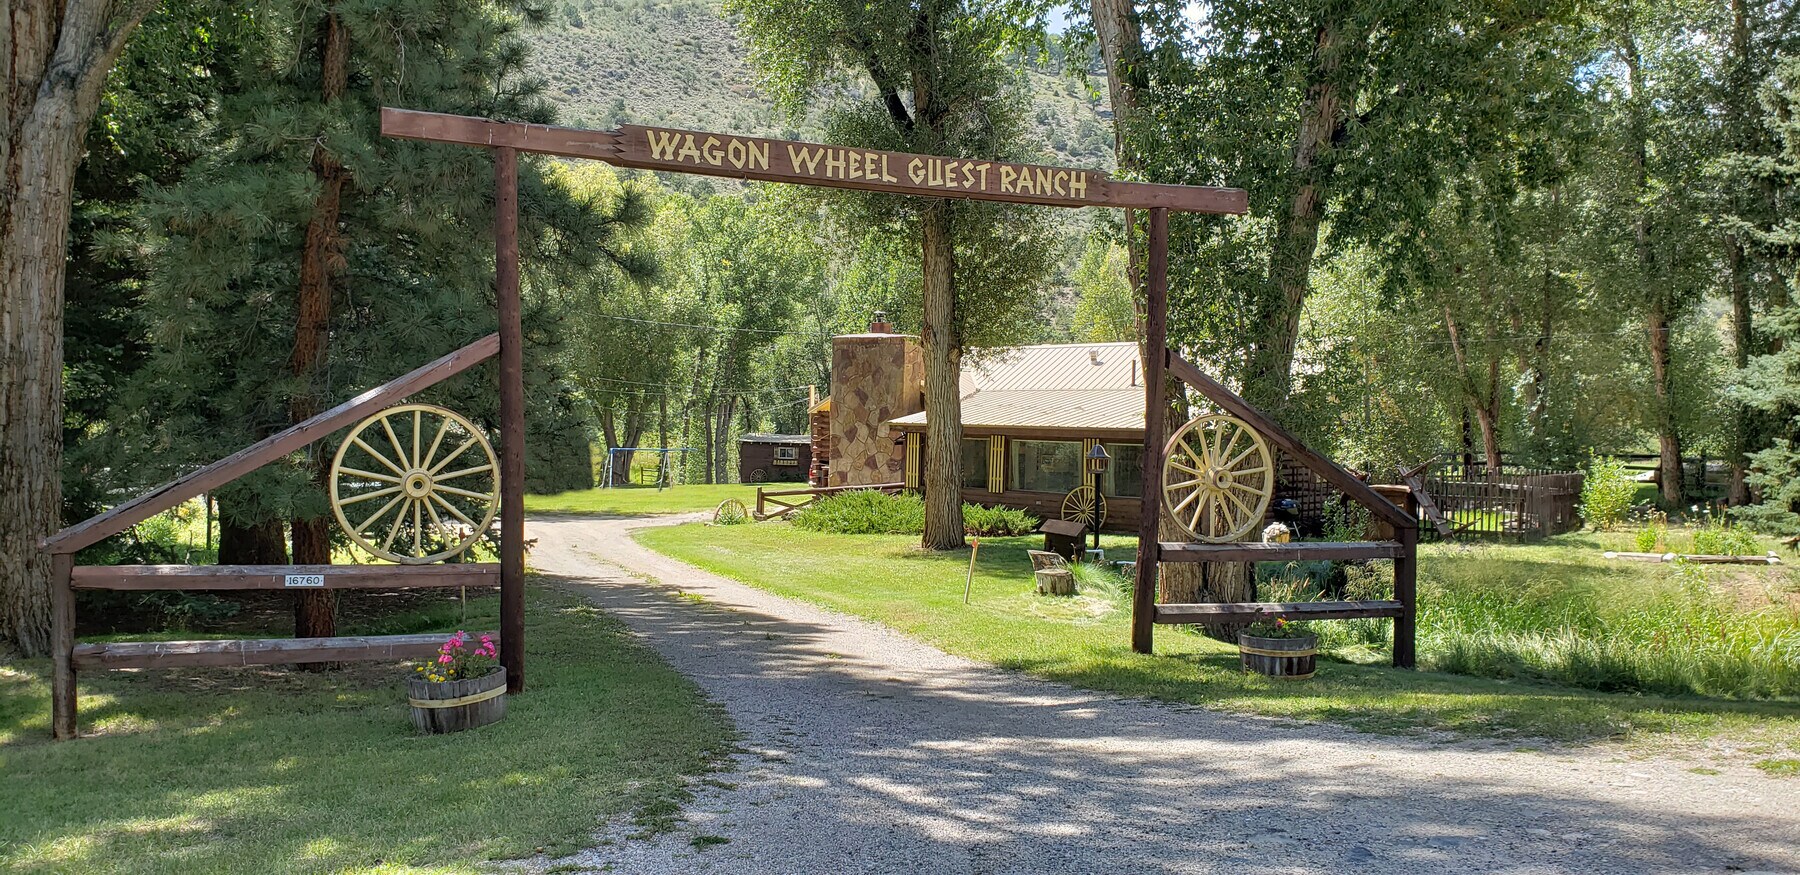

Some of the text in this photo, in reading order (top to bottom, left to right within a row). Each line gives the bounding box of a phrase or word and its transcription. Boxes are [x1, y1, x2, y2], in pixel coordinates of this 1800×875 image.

[646, 130, 1087, 199] WAGON WHEEL GUEST RANCH
[288, 576, 320, 585] 16760
